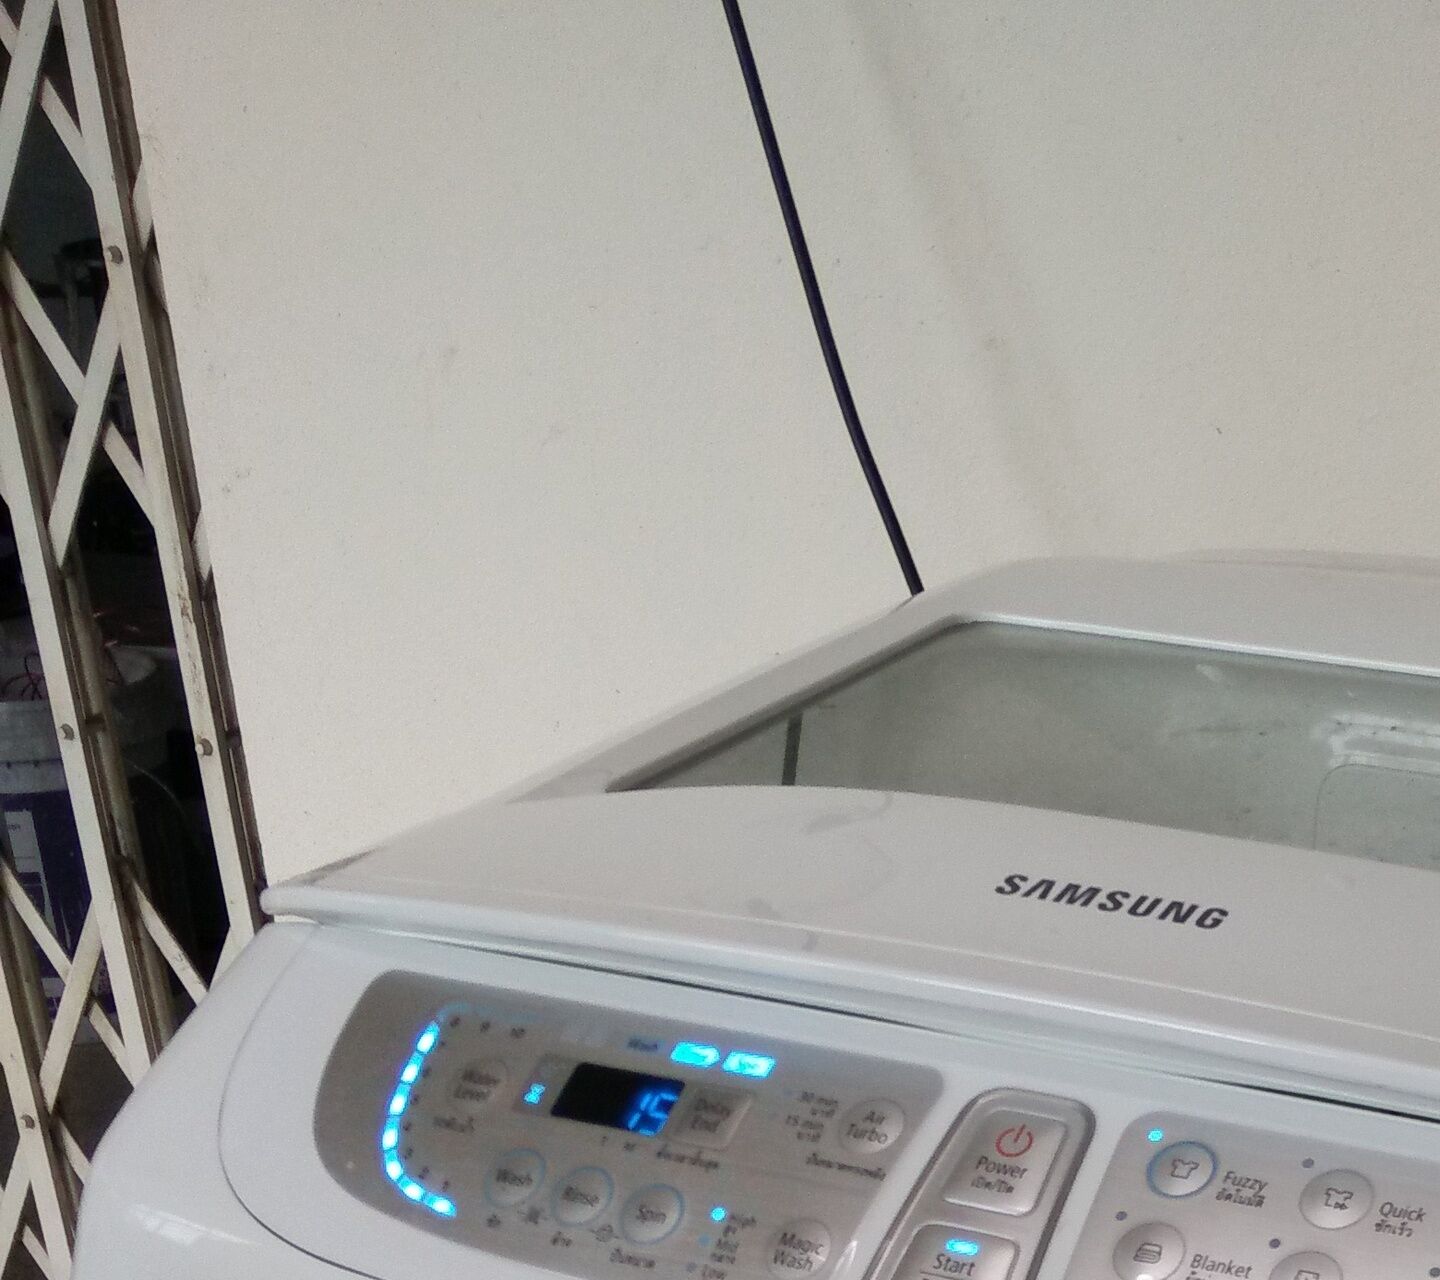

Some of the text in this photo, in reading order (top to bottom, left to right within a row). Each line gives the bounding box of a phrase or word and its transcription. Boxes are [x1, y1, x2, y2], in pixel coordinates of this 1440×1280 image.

[995, 874, 1228, 929] SAMSUNG
[863, 1110, 886, 1126] Air
[847, 1123, 888, 1145] Turbo
[975, 1155, 1028, 1181] Power
[1222, 1171, 1269, 1194] Fuzzy
[637, 1203, 667, 1225] Spin
[1379, 1201, 1426, 1223] Quick
[779, 1232, 824, 1255] Magic
[773, 1249, 814, 1272] Wash
[932, 1253, 976, 1277] Start
[1190, 1253, 1253, 1280] Blanket
